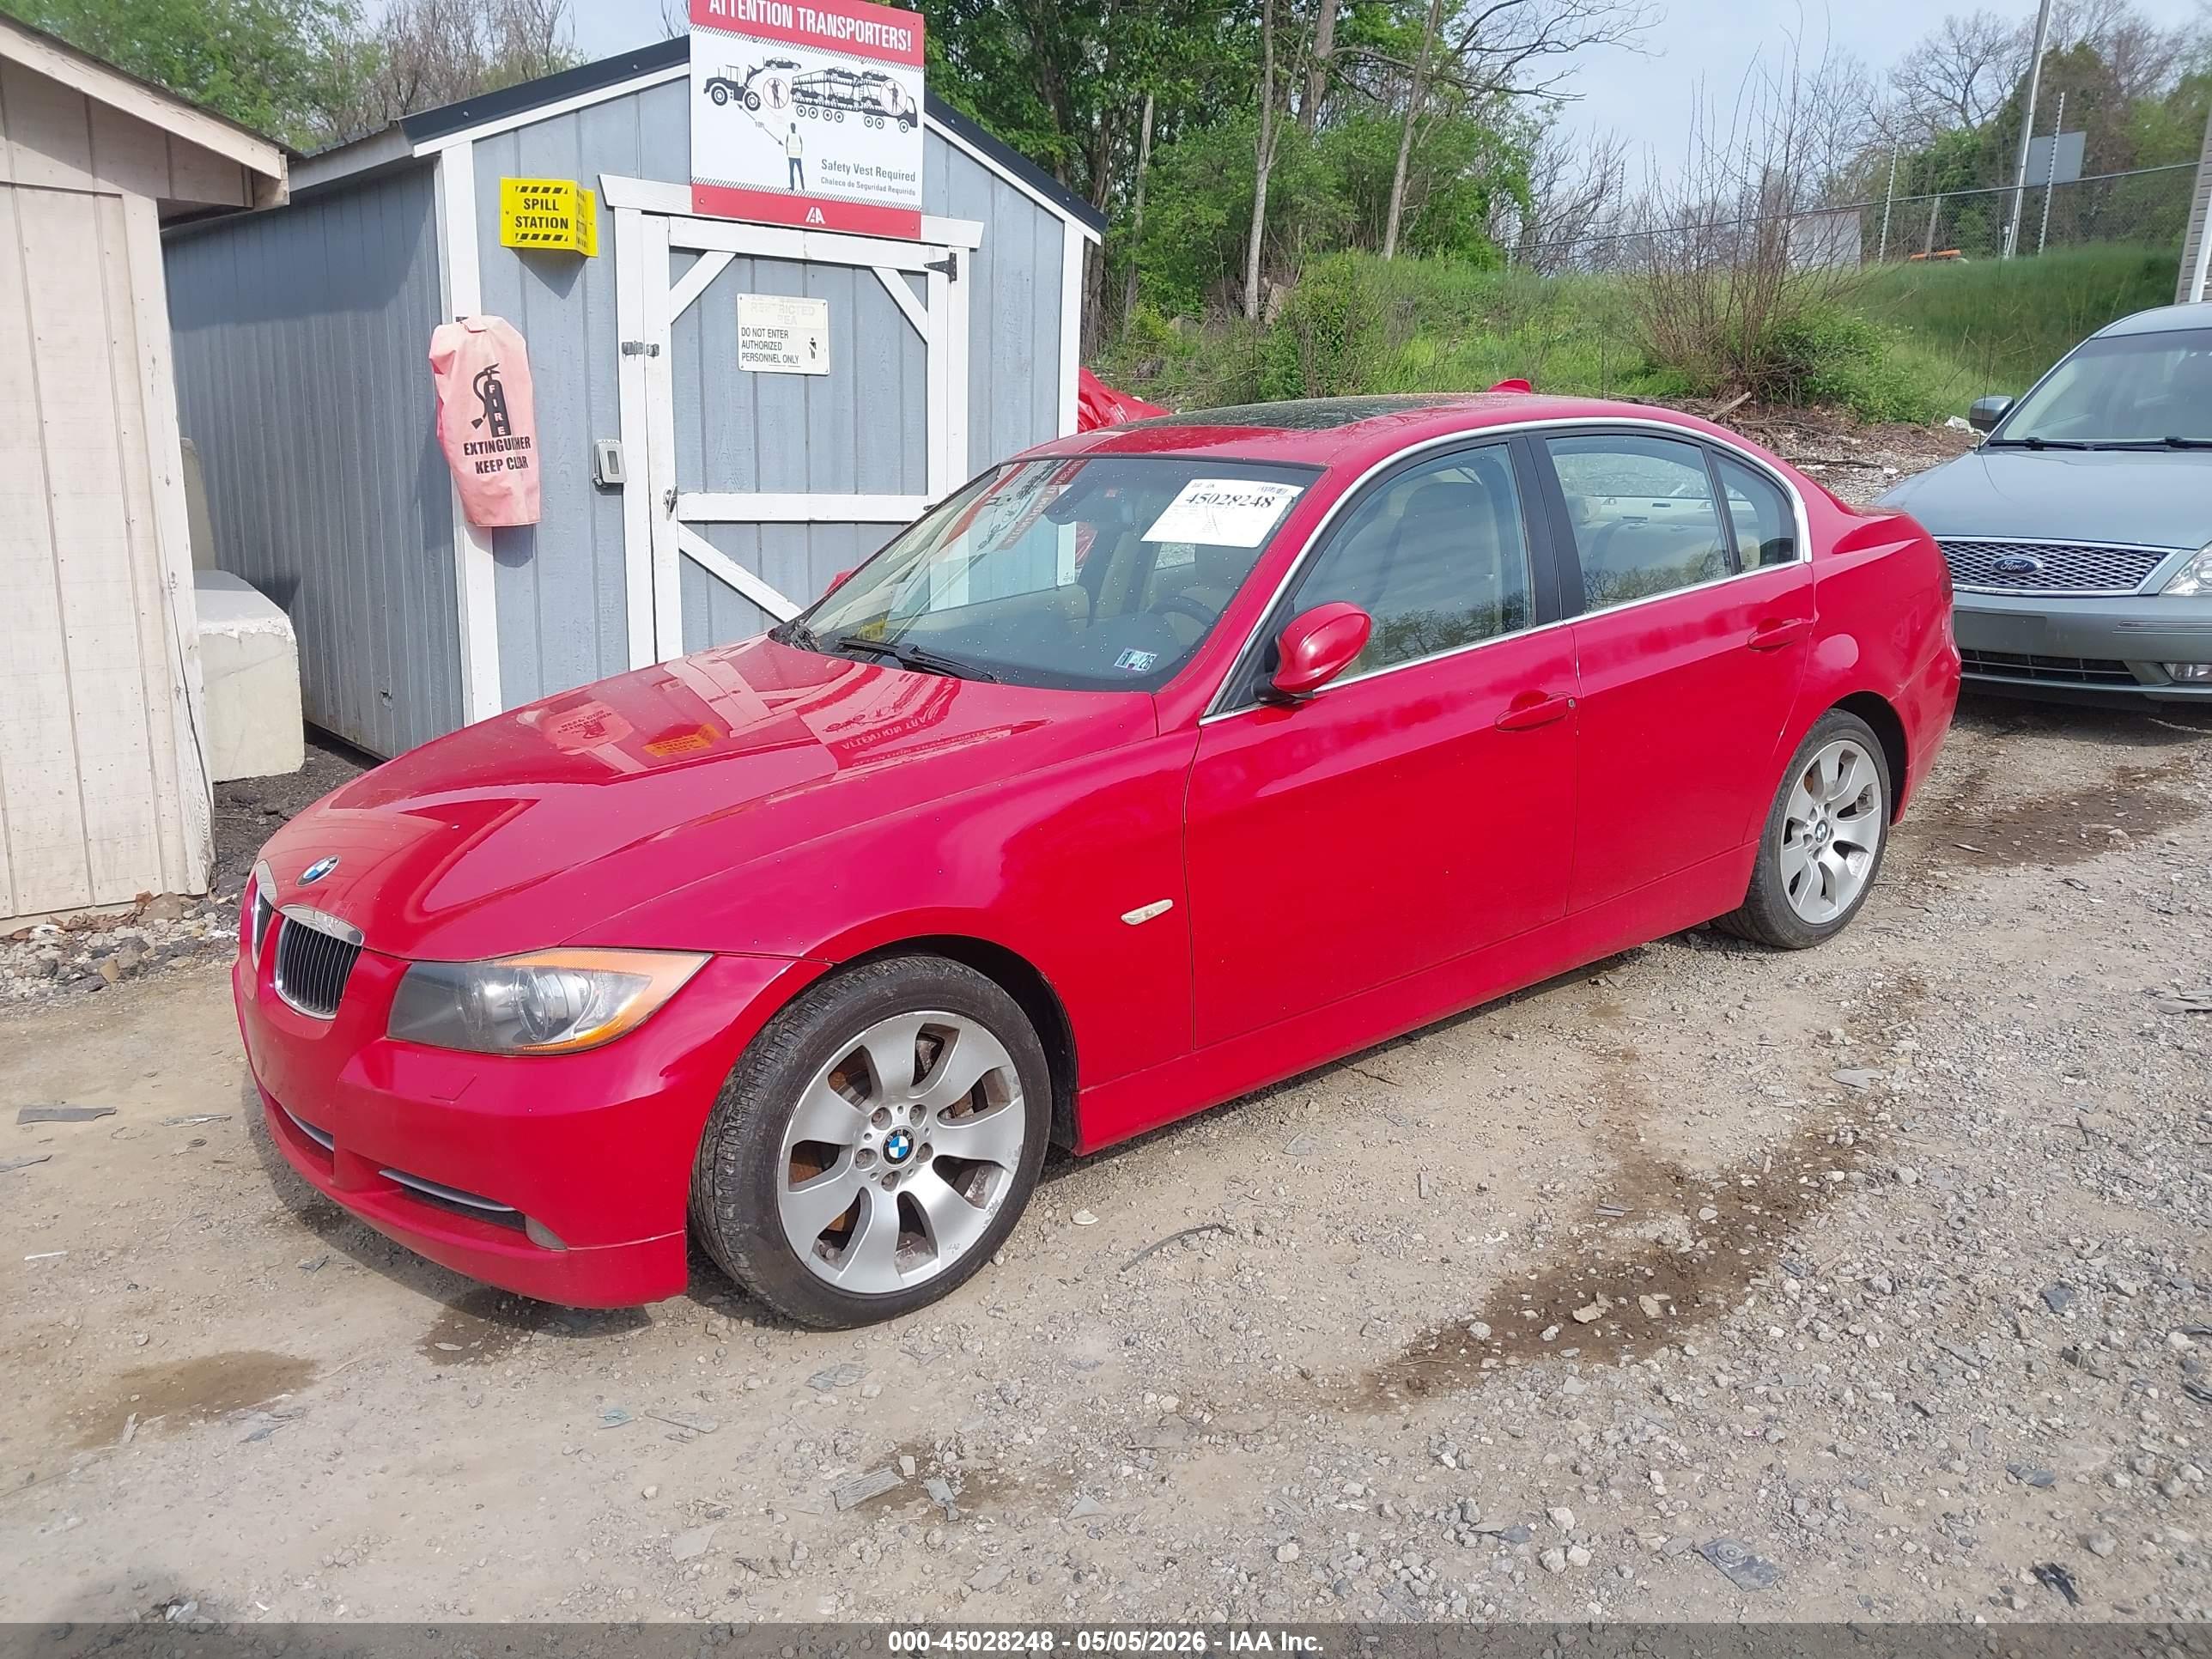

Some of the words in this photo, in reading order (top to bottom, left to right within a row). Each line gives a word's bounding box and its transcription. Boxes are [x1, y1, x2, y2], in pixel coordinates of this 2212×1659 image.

[709, 0, 793, 28] ATTENTION
[797, 7, 911, 52] TRANSPORTERS!
[821, 159, 851, 175] Safety
[854, 163, 873, 176] Vest
[876, 167, 915, 182] Required
[524, 198, 559, 210] SPILL
[515, 216, 568, 229] STATION
[741, 327, 750, 337] DO
[752, 327, 765, 337] NOT
[768, 329, 788, 339] ENTER
[741, 340, 782, 350] AUTHORIZED
[741, 352, 781, 363] PERSONNEL
[782, 355, 799, 364] ONLY
[463, 436, 532, 456] EXTINGUIHER
[475, 459, 503, 474] KEEP
[1186, 493, 1275, 508] 45028248
[2000, 560, 2027, 570] Ford
